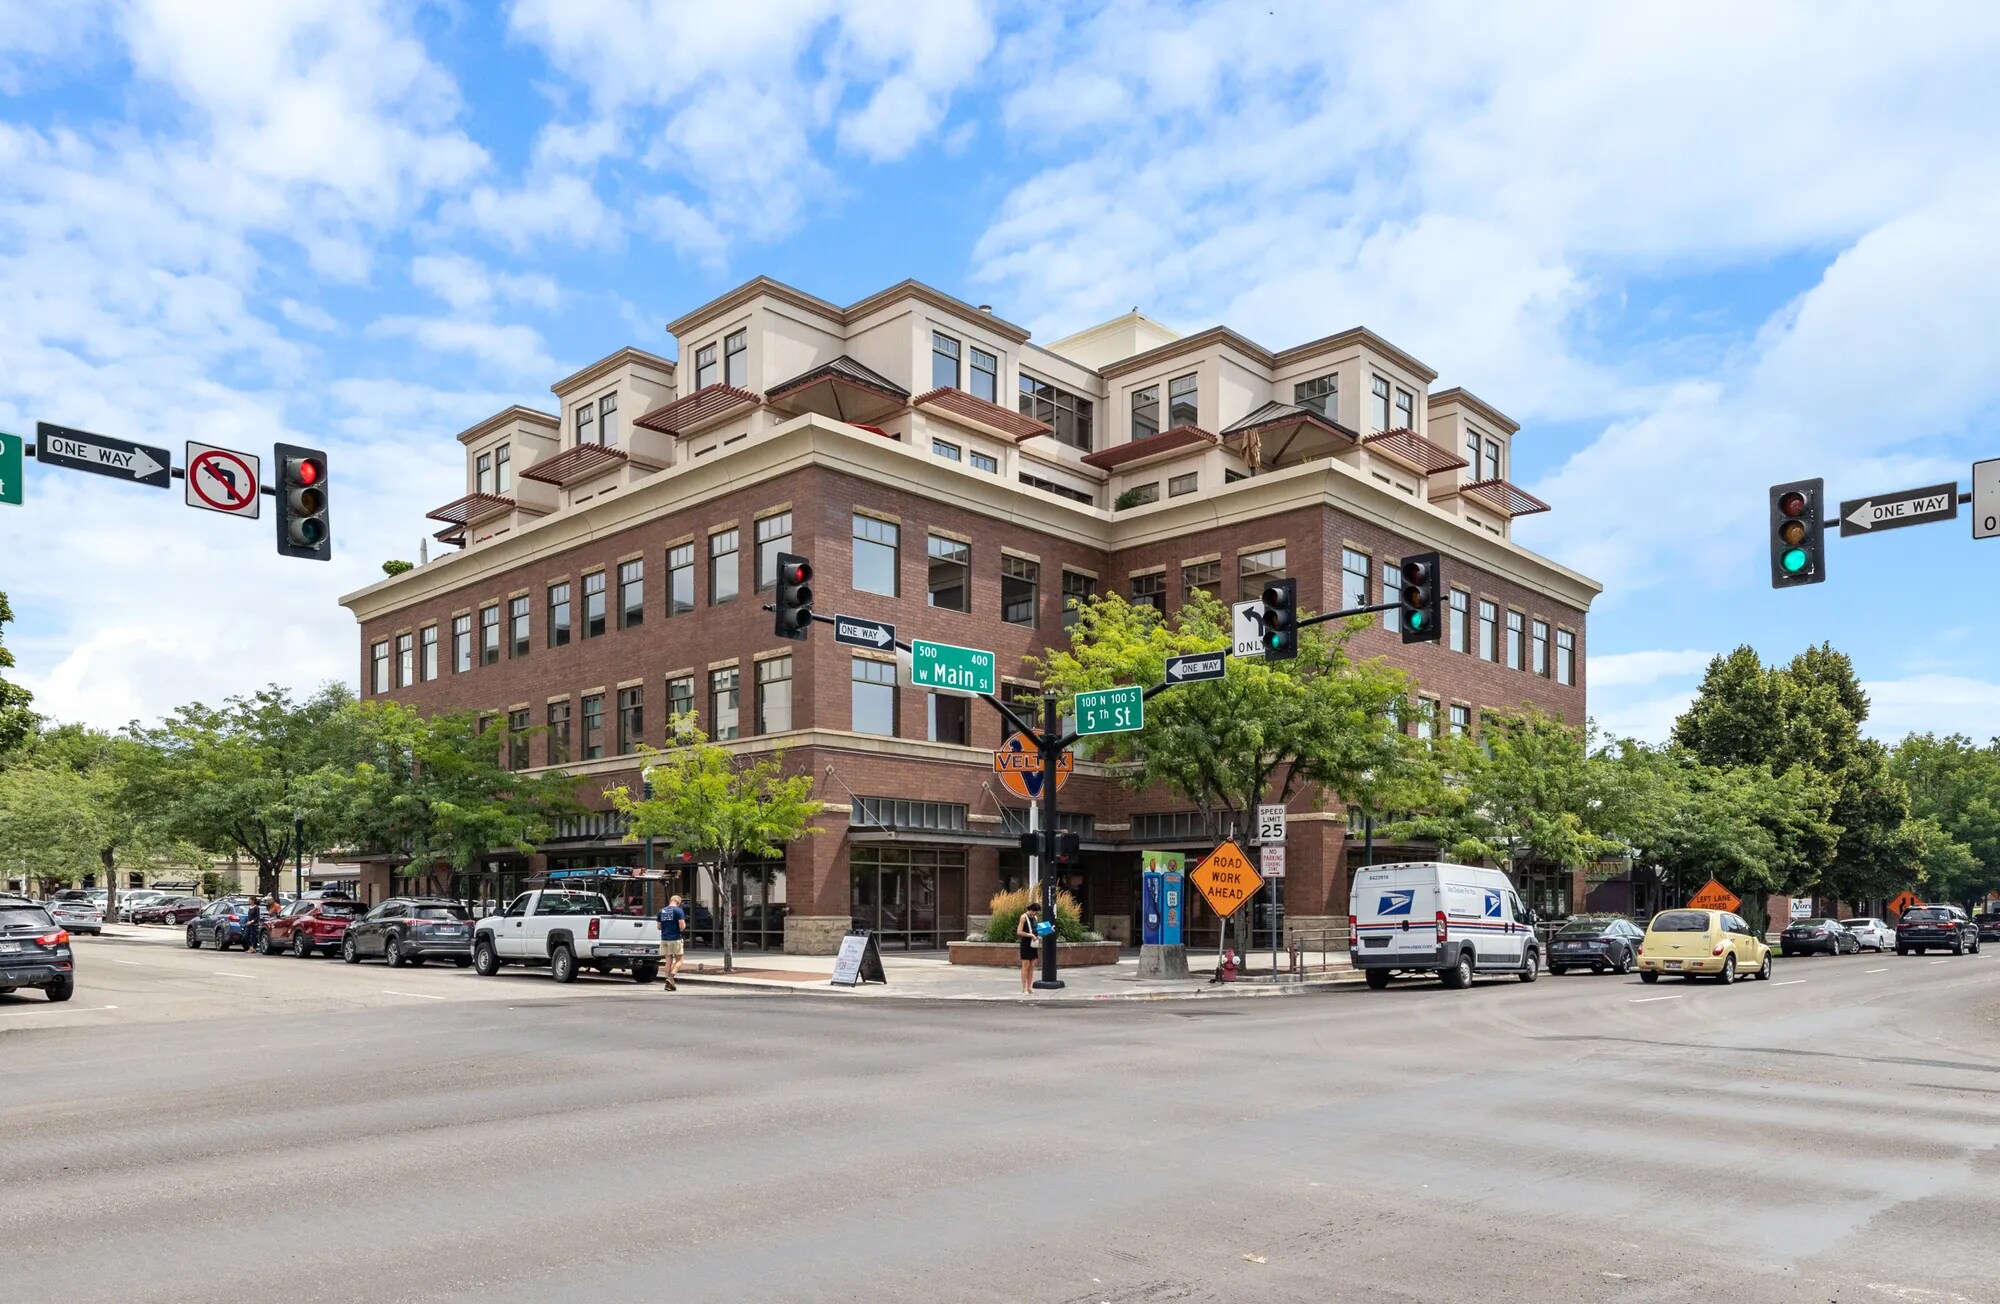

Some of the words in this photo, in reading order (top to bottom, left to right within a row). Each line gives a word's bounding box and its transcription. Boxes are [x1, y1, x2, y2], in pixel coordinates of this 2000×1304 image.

[51, 439, 88, 458] ONE
[99, 449, 133, 468] WAY
[1873, 503, 1905, 520] ONE
[1913, 496, 1945, 513] WAY
[841, 625, 858, 637] ONE
[861, 629, 878, 640] WAY
[919, 645, 938, 659] 500
[971, 654, 988, 667] 400
[1182, 664, 1198, 674] ONE
[1202, 660, 1219, 671] WAY
[919, 669, 928, 681] W
[934, 662, 974, 688] Main
[979, 678, 988, 690] St
[1081, 696, 1097, 707] 100
[1100, 695, 1106, 706] N
[1110, 693, 1127, 705] 100
[1130, 691, 1136, 702] S
[1087, 711, 1095, 730] 5
[1099, 709, 1109, 720] Th
[1114, 707, 1131, 728] St
[997, 753, 1068, 770] VELTX
[1261, 824, 1283, 838] 25
[1213, 857, 1242, 869] ROAD
[1212, 872, 1241, 885] WORK
[1208, 887, 1243, 899] AHEAD
